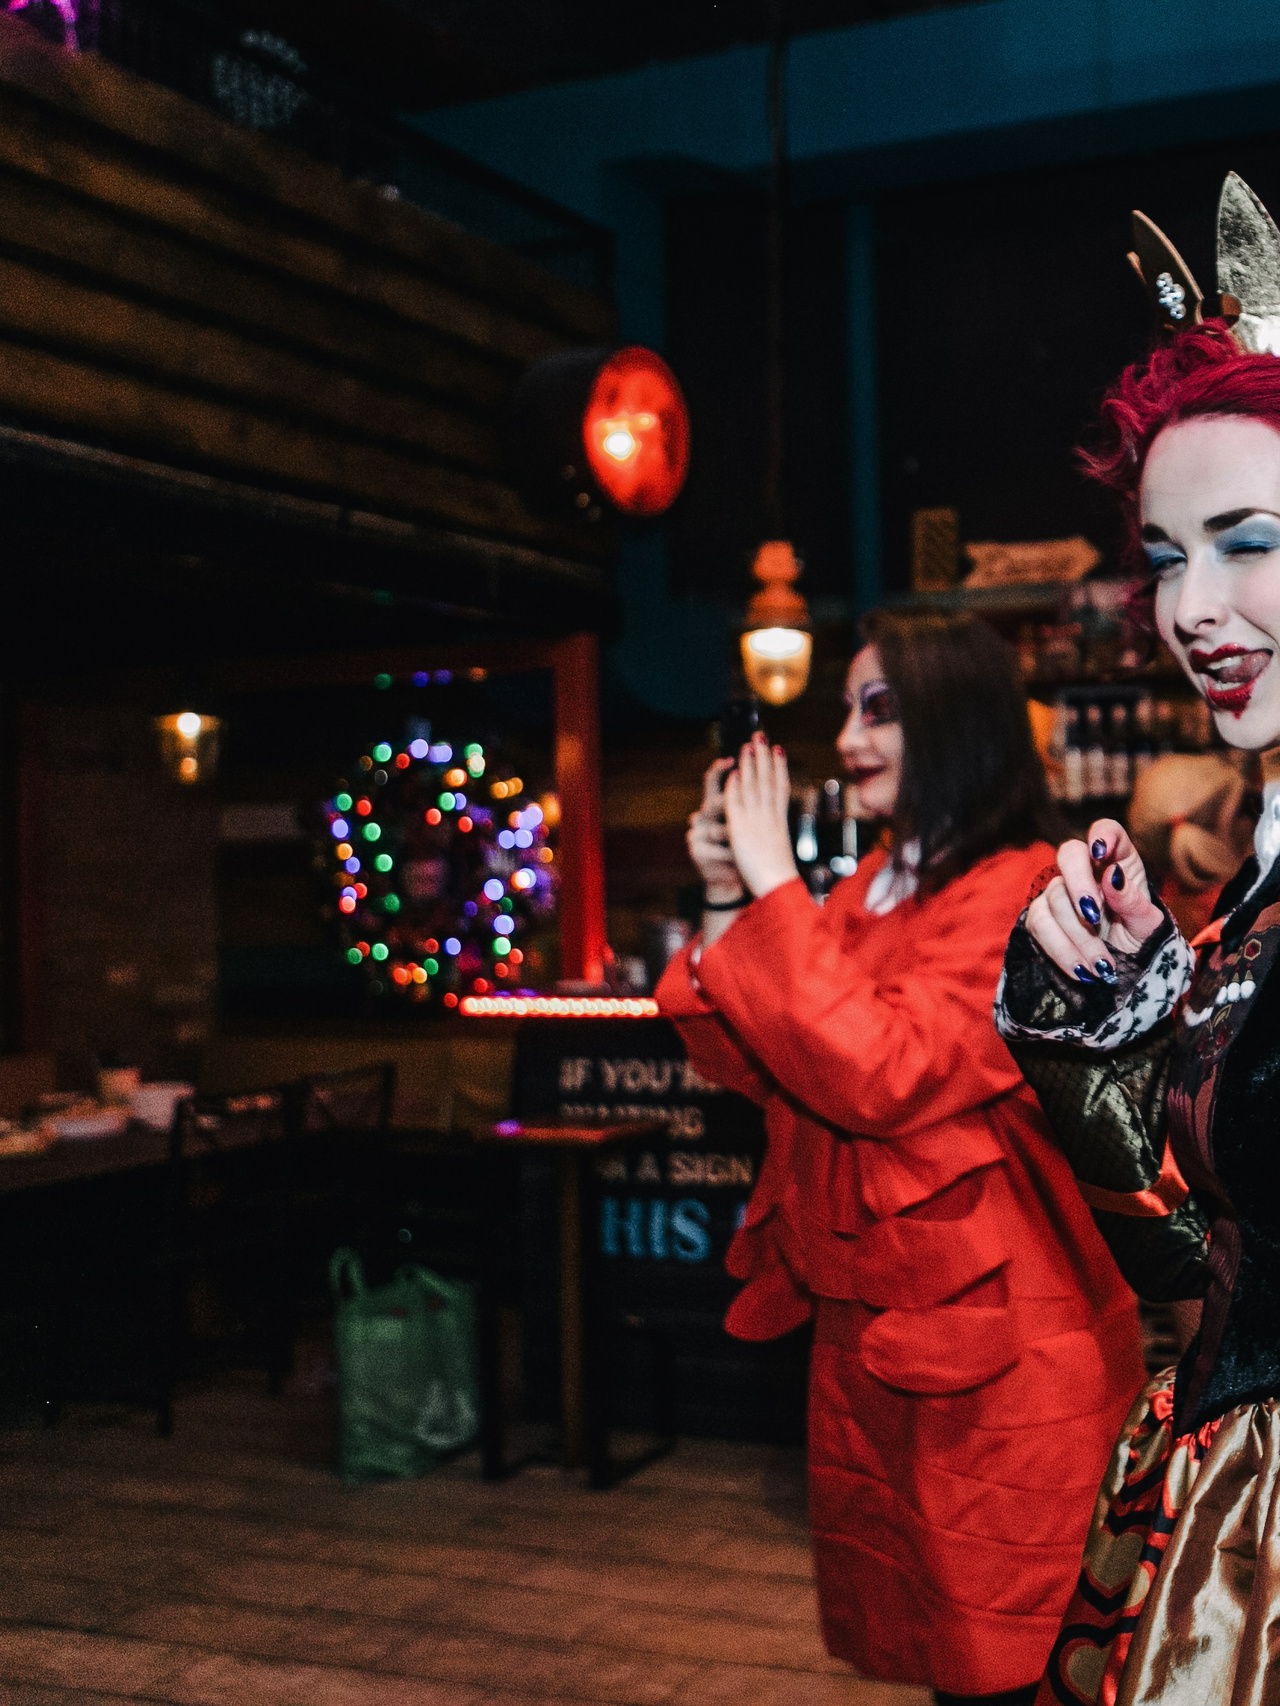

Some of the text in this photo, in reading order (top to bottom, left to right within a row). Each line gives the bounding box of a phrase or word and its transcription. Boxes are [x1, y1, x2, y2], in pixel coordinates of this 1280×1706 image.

[558, 1056, 592, 1092] IF
[636, 1151, 661, 1184] A
[667, 1151, 753, 1187] SIGN
[599, 1196, 711, 1264] HIS
